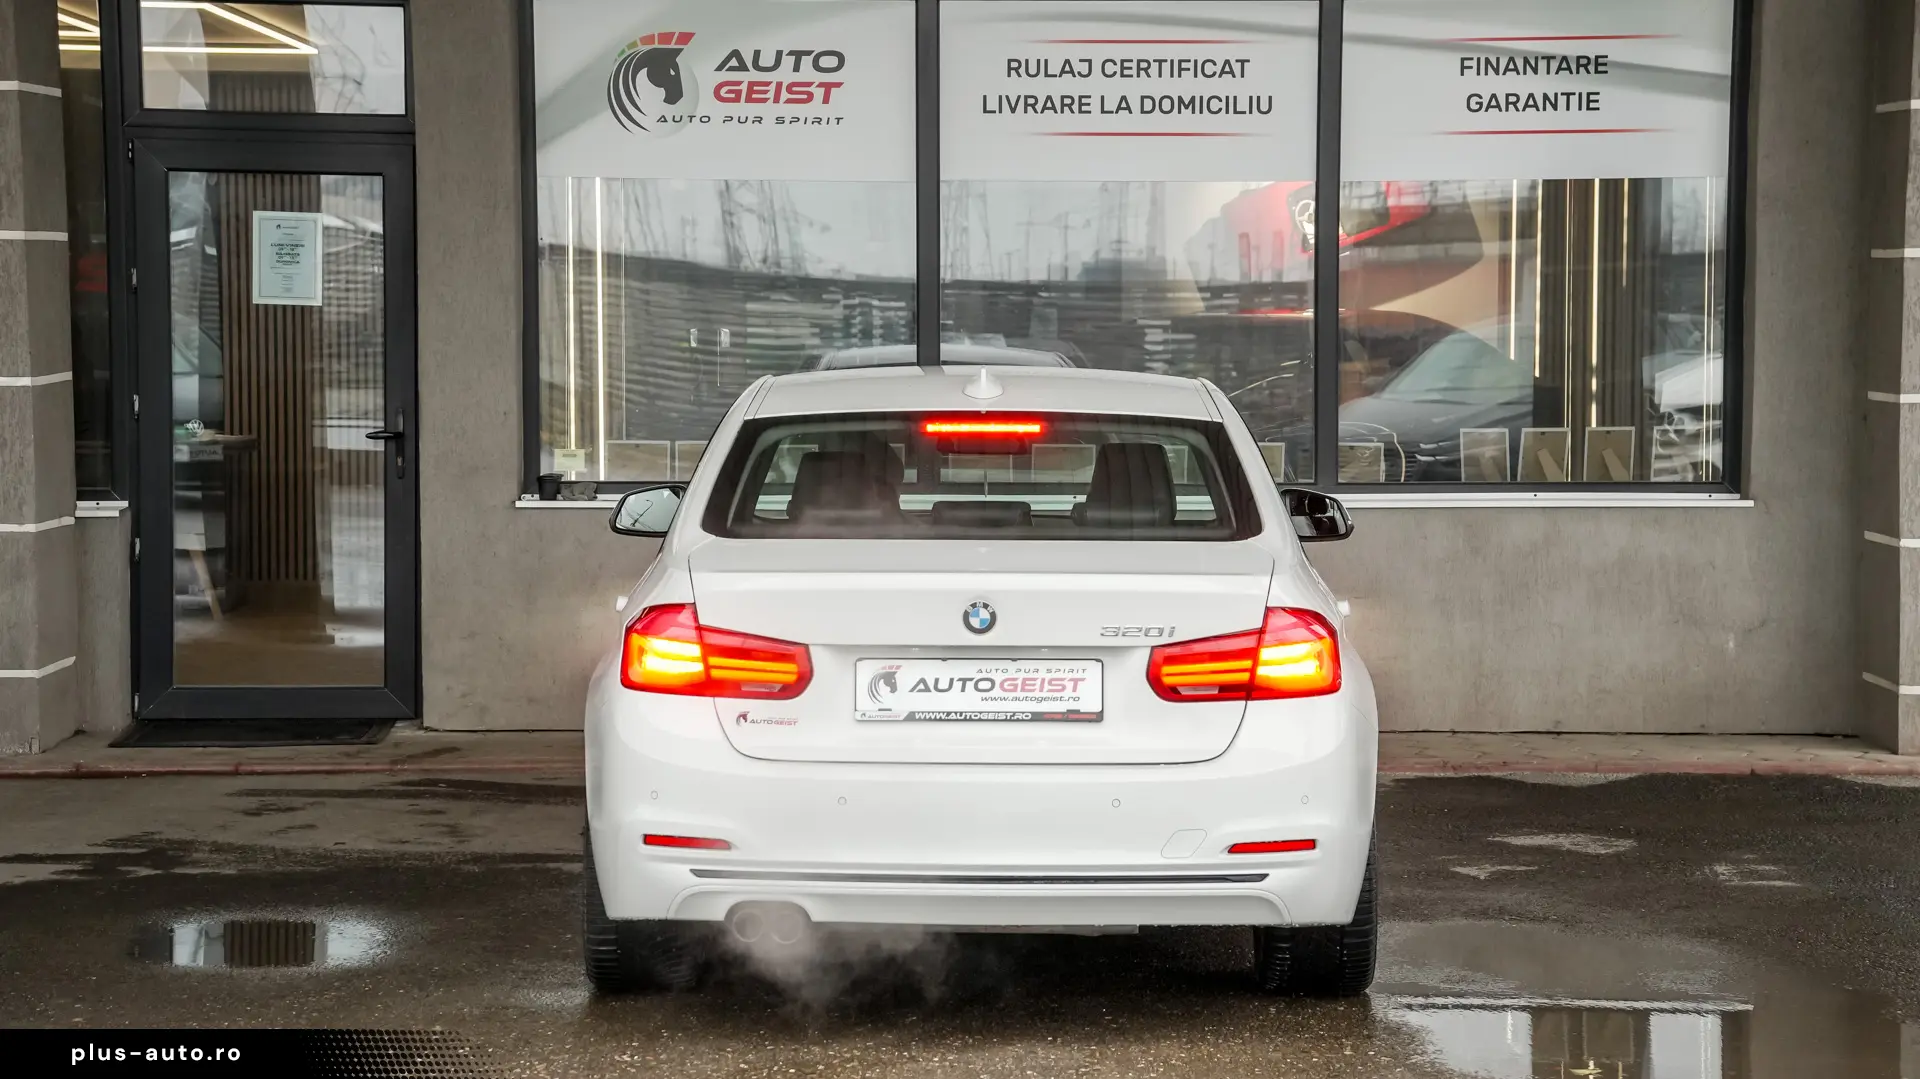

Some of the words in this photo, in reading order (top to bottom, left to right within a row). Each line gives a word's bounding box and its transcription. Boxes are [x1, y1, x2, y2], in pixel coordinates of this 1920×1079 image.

[713, 48, 846, 74] AUTO
[1006, 58, 1093, 79] RULAJ
[1100, 58, 1251, 79] CERTIFICAT
[1459, 54, 1609, 77] FINANTARE
[712, 80, 845, 105] GEIST
[1466, 91, 1601, 113] GARANTIE
[982, 94, 1092, 115] LIVRARE
[1100, 94, 1133, 115] LA
[1139, 94, 1274, 115] DOMICILIU
[656, 114, 712, 124] AUTO
[722, 115, 764, 125] PUR
[774, 116, 844, 126] SPIRIT
[1099, 625, 1176, 638] 320i
[980, 695, 1081, 704] www.autogeist.ro
[749, 718, 799, 726] AUTOGEIST
[915, 712, 1032, 720] WWW.AUTOGEIST.RO
